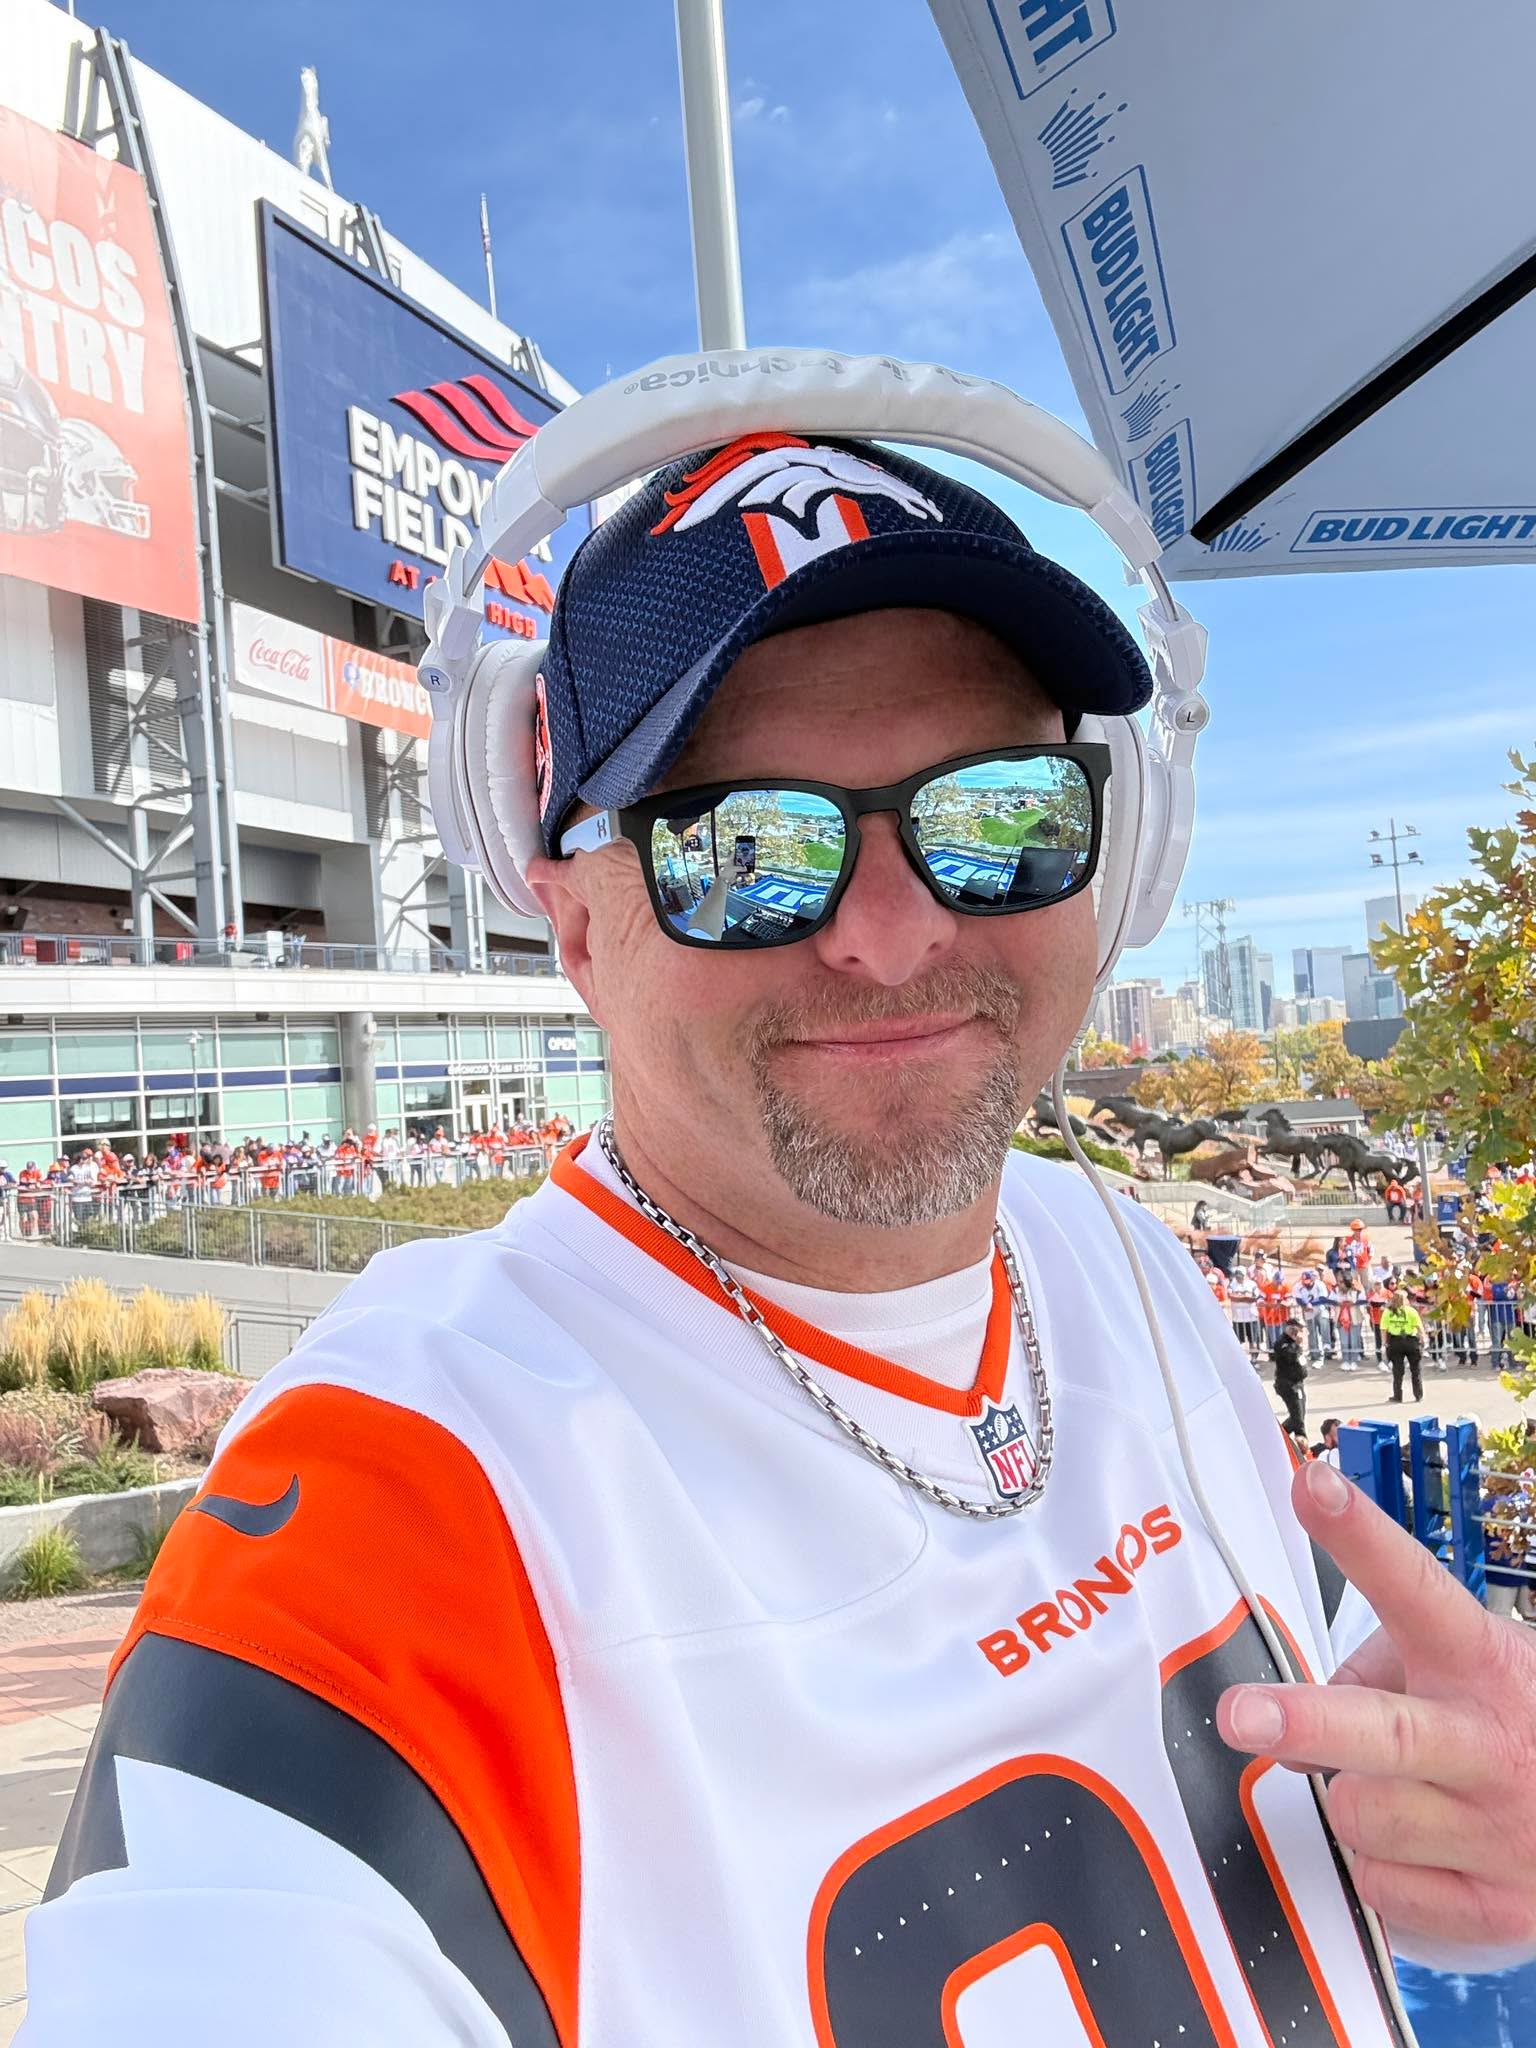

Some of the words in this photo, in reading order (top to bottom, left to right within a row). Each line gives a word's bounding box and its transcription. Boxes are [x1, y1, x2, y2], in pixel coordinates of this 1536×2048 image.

[1019, 0, 1093, 66] HT
[0, 199, 145, 328] COS
[1083, 185, 1140, 287] BUD
[1104, 264, 1161, 379] LIGHT
[1145, 432, 1181, 495] BUD
[1152, 478, 1184, 544] LIGHT
[1307, 517, 1410, 543] BUD
[1408, 514, 1536, 541] LIGHT
[389, 559, 420, 590] AT
[488, 601, 537, 639] HIGH
[359, 666, 433, 717] BRONC
[430, 675, 441, 686] R
[1187, 711, 1195, 723] L
